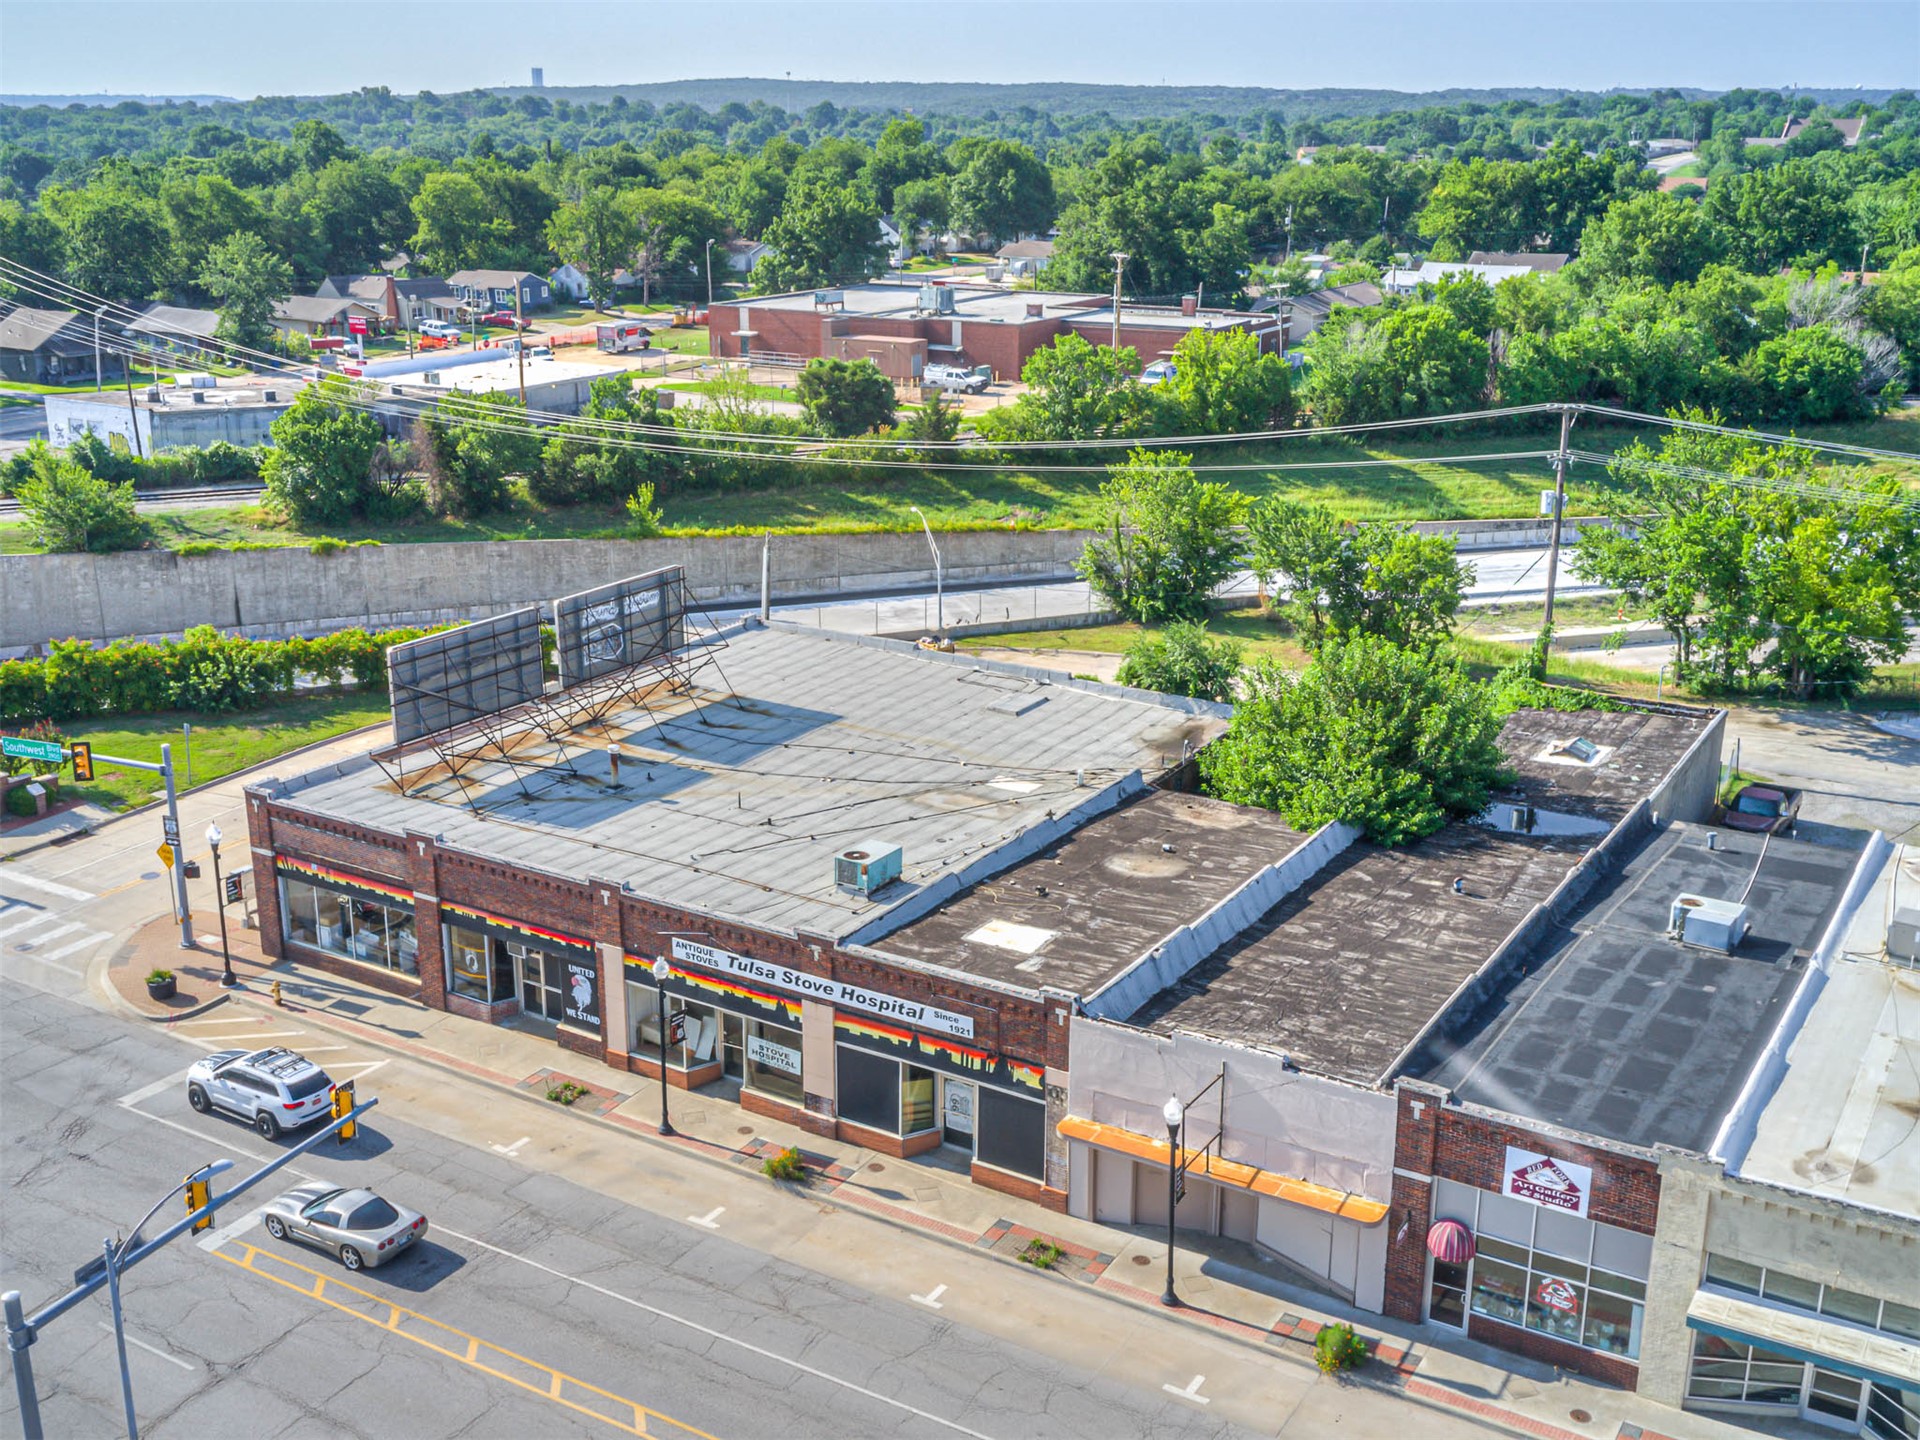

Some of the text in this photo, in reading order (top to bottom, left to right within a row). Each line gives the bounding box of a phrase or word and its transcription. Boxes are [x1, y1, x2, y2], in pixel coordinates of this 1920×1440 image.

[5, 741, 45, 756] Southwest
[675, 941, 715, 958] ANTIQUE
[685, 952, 719, 968] STOVES
[568, 964, 596, 979] UNITED
[727, 955, 925, 1020] Tulsa Stove Hospital
[566, 1007, 601, 1026] WE STAND
[933, 1010, 960, 1024] Since
[948, 1024, 971, 1037] 1921
[752, 1048, 796, 1069] HOSPITAL
[758, 1044, 791, 1060] STOVE
[1526, 1162, 1570, 1186] RED FORK
[1514, 1180, 1579, 1204] Art Gallery
[1520, 1189, 1572, 1208] & Studio
